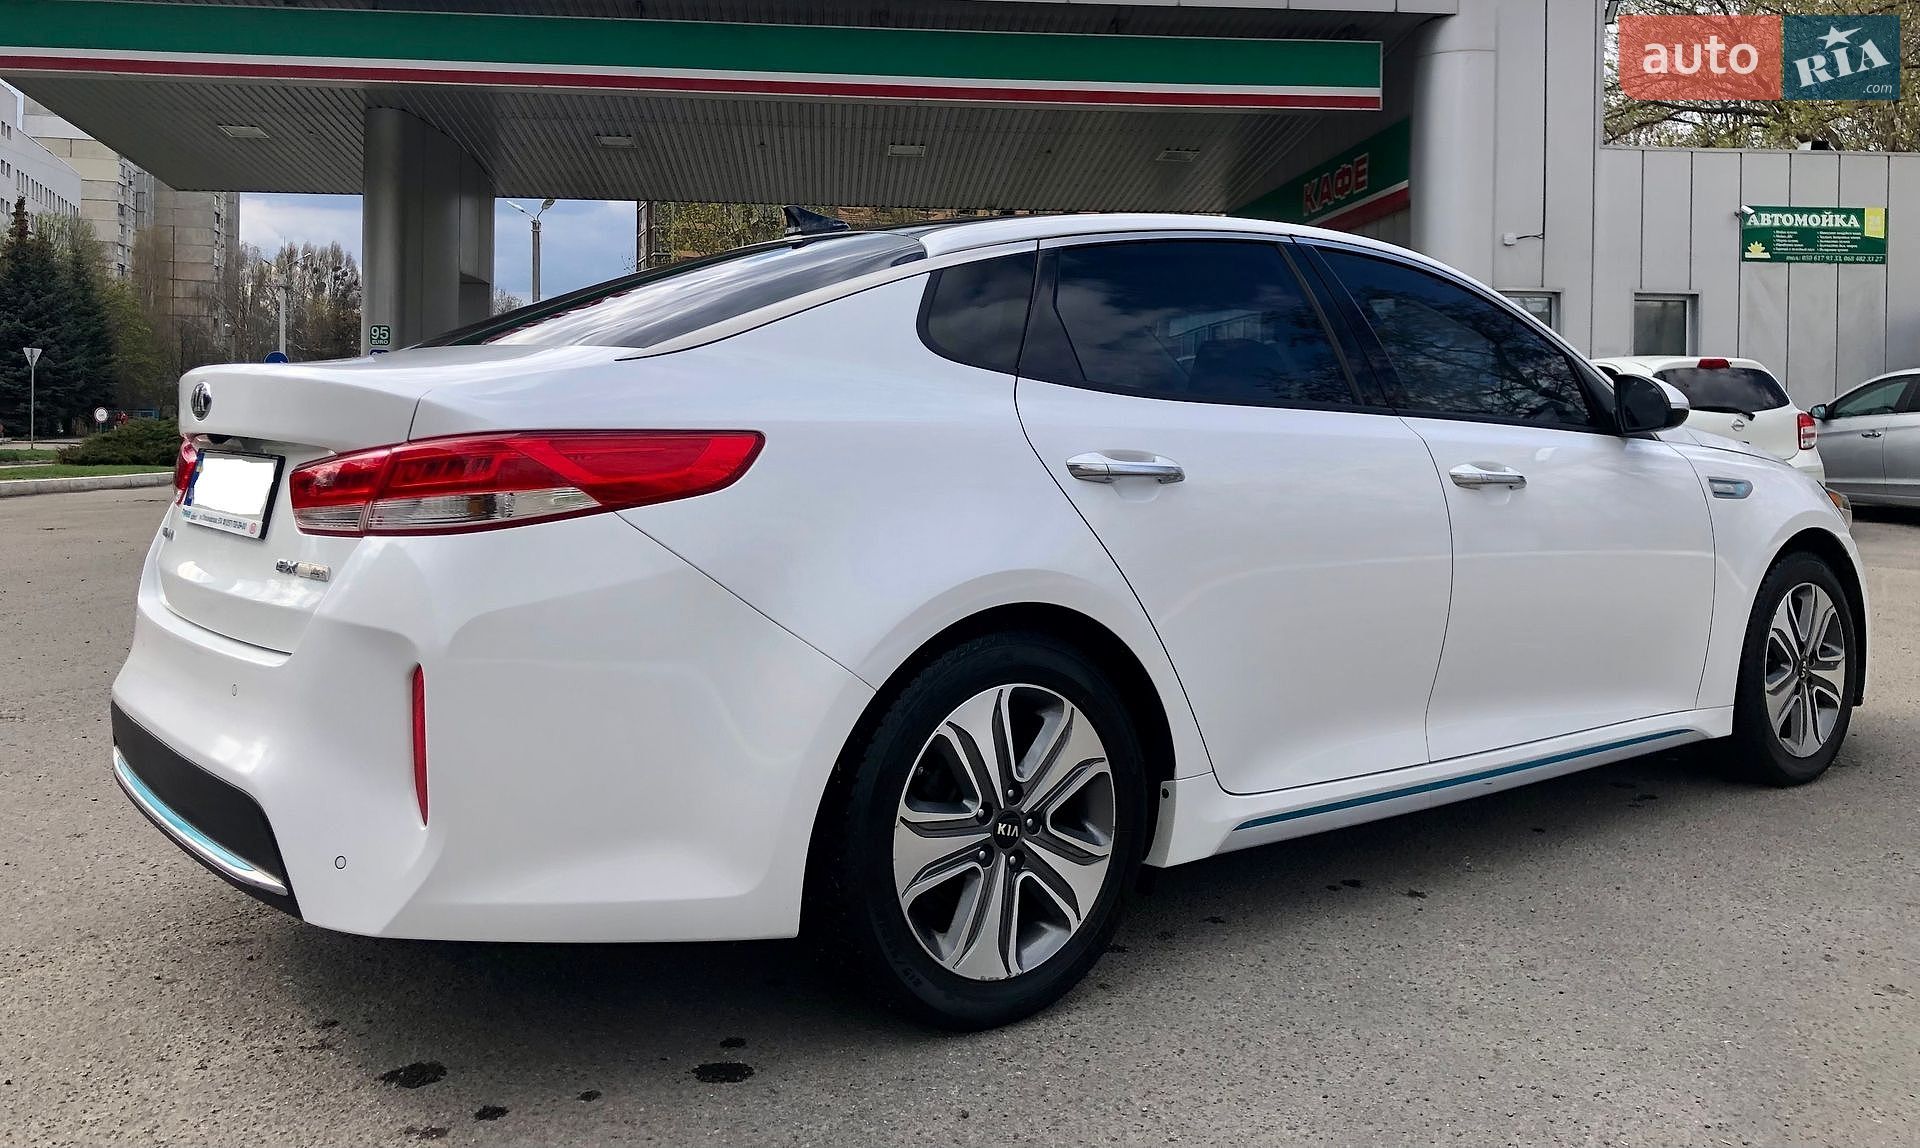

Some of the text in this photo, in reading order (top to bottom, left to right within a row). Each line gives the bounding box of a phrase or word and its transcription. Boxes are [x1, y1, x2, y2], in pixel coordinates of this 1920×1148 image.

[1303, 152, 1369, 217] КАФЕ
[1746, 211, 1861, 228] АВТОМОЙКА
[371, 326, 389, 340] 95
[997, 822, 1019, 838] KIA
